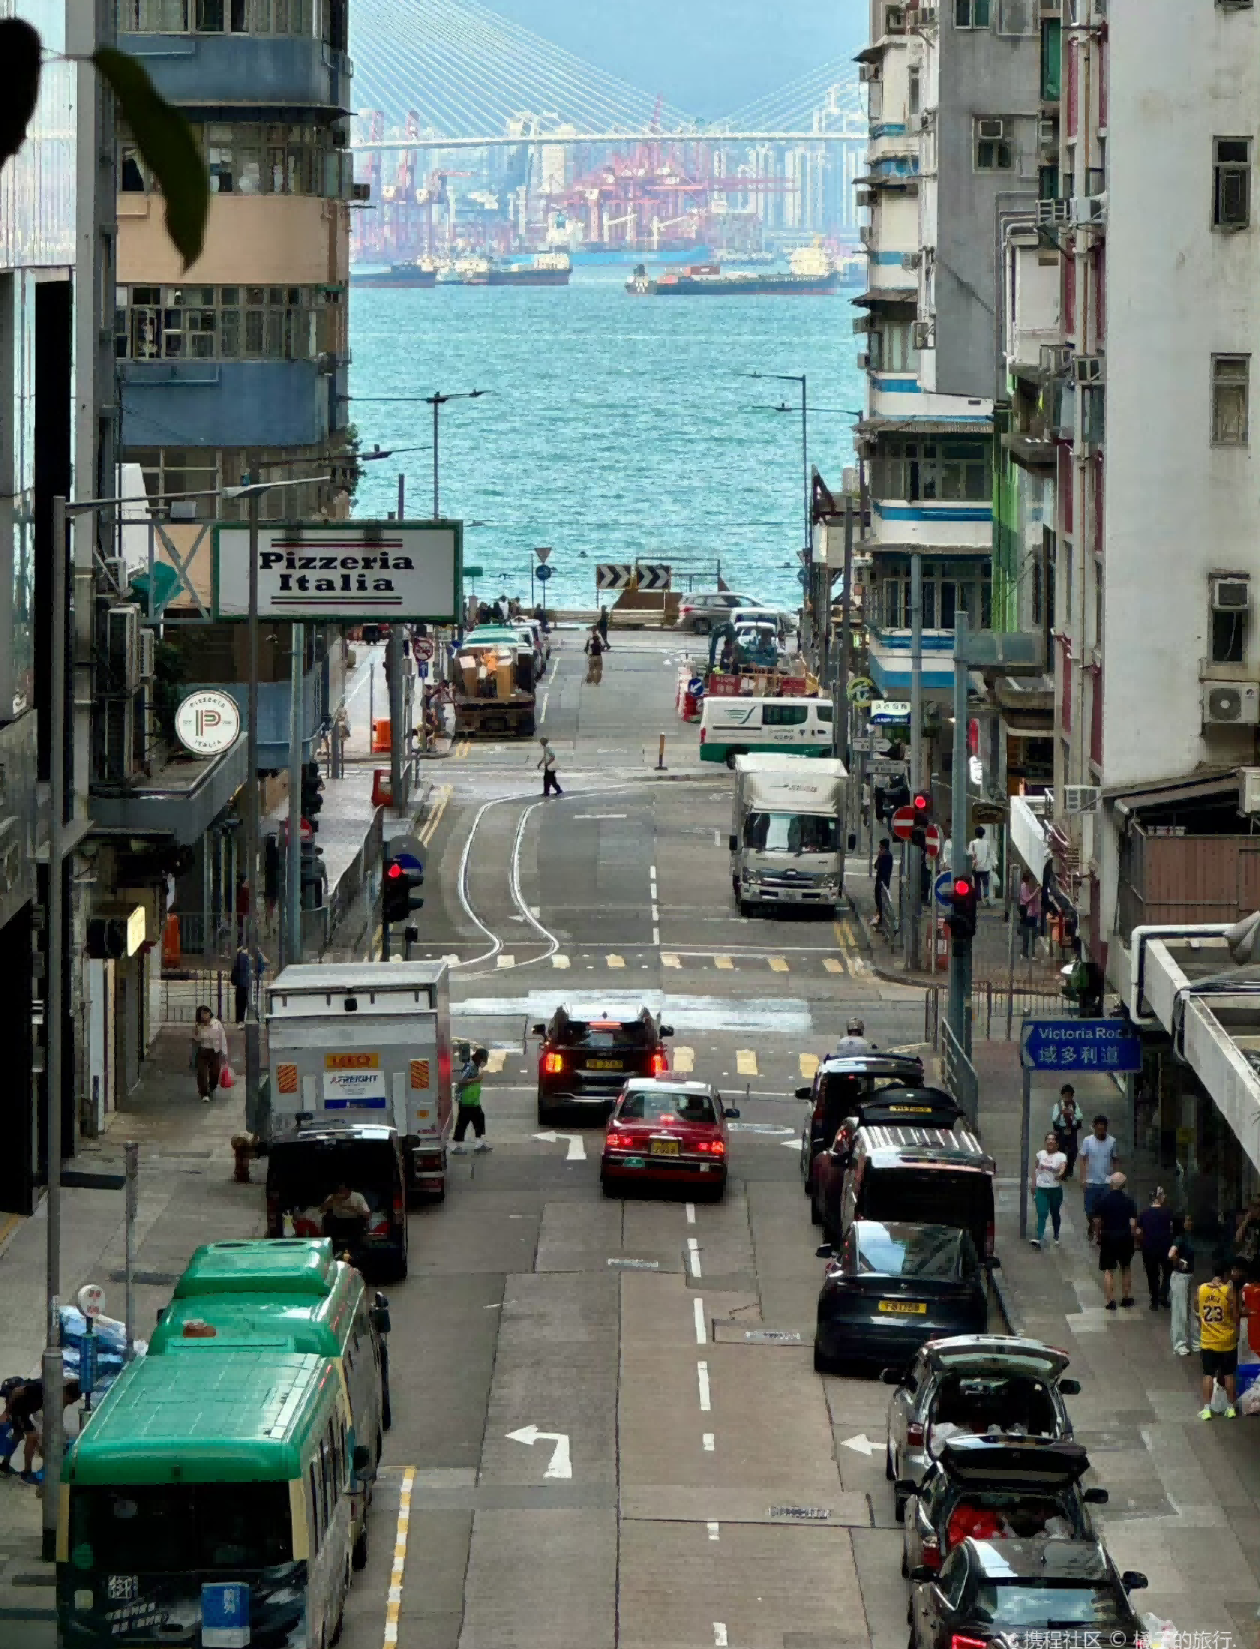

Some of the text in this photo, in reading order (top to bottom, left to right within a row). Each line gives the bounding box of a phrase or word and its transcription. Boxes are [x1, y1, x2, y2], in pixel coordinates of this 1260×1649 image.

[259, 551, 415, 570] Pizzeria
[279, 573, 394, 592] Italia
[1038, 1027, 1093, 1039] Victoria
[1203, 1305, 1223, 1322] 23
